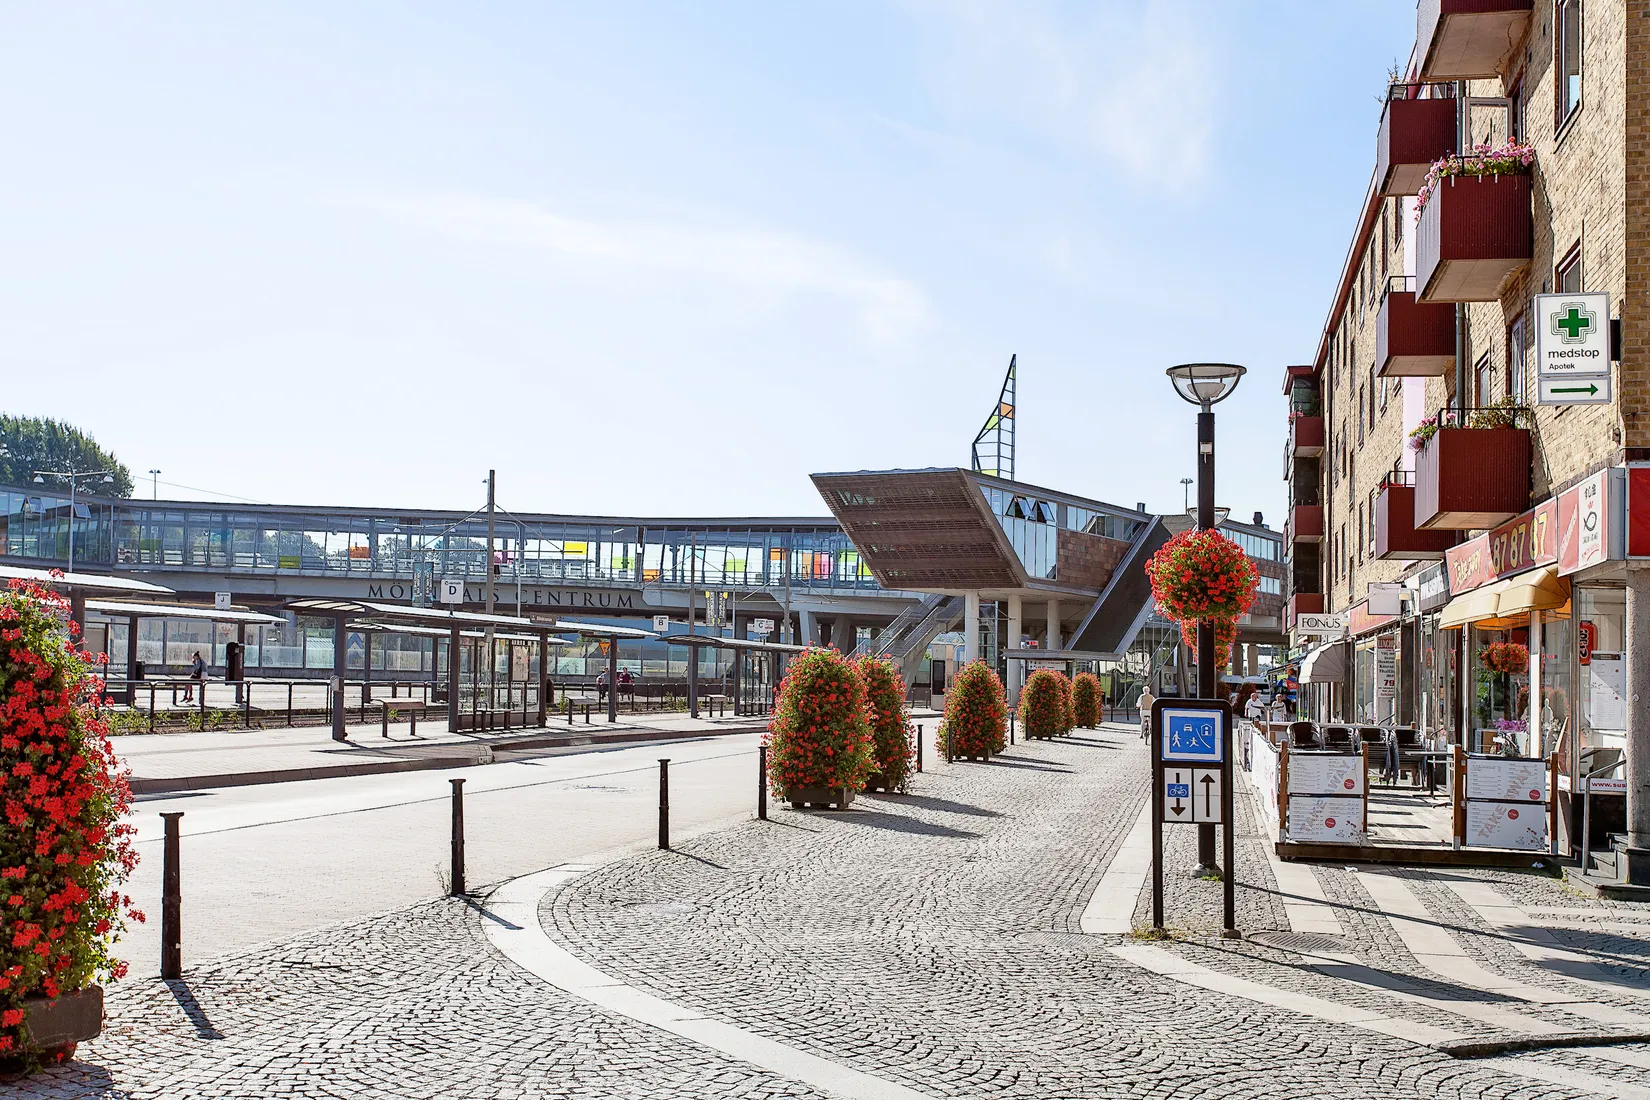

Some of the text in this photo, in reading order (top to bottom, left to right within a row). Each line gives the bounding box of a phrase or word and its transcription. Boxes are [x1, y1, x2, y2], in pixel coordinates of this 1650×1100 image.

[1548, 348, 1600, 359] medstop
[1548, 362, 1576, 370] Apotek
[1493, 532, 1508, 575] 87
[1510, 522, 1526, 568] 87
[1529, 511, 1548, 562] 87
[368, 582, 500, 602] MÖALS
[515, 588, 633, 609] CENTRUM
[448, 585, 457, 595] D
[1477, 804, 1508, 839] TAKE
